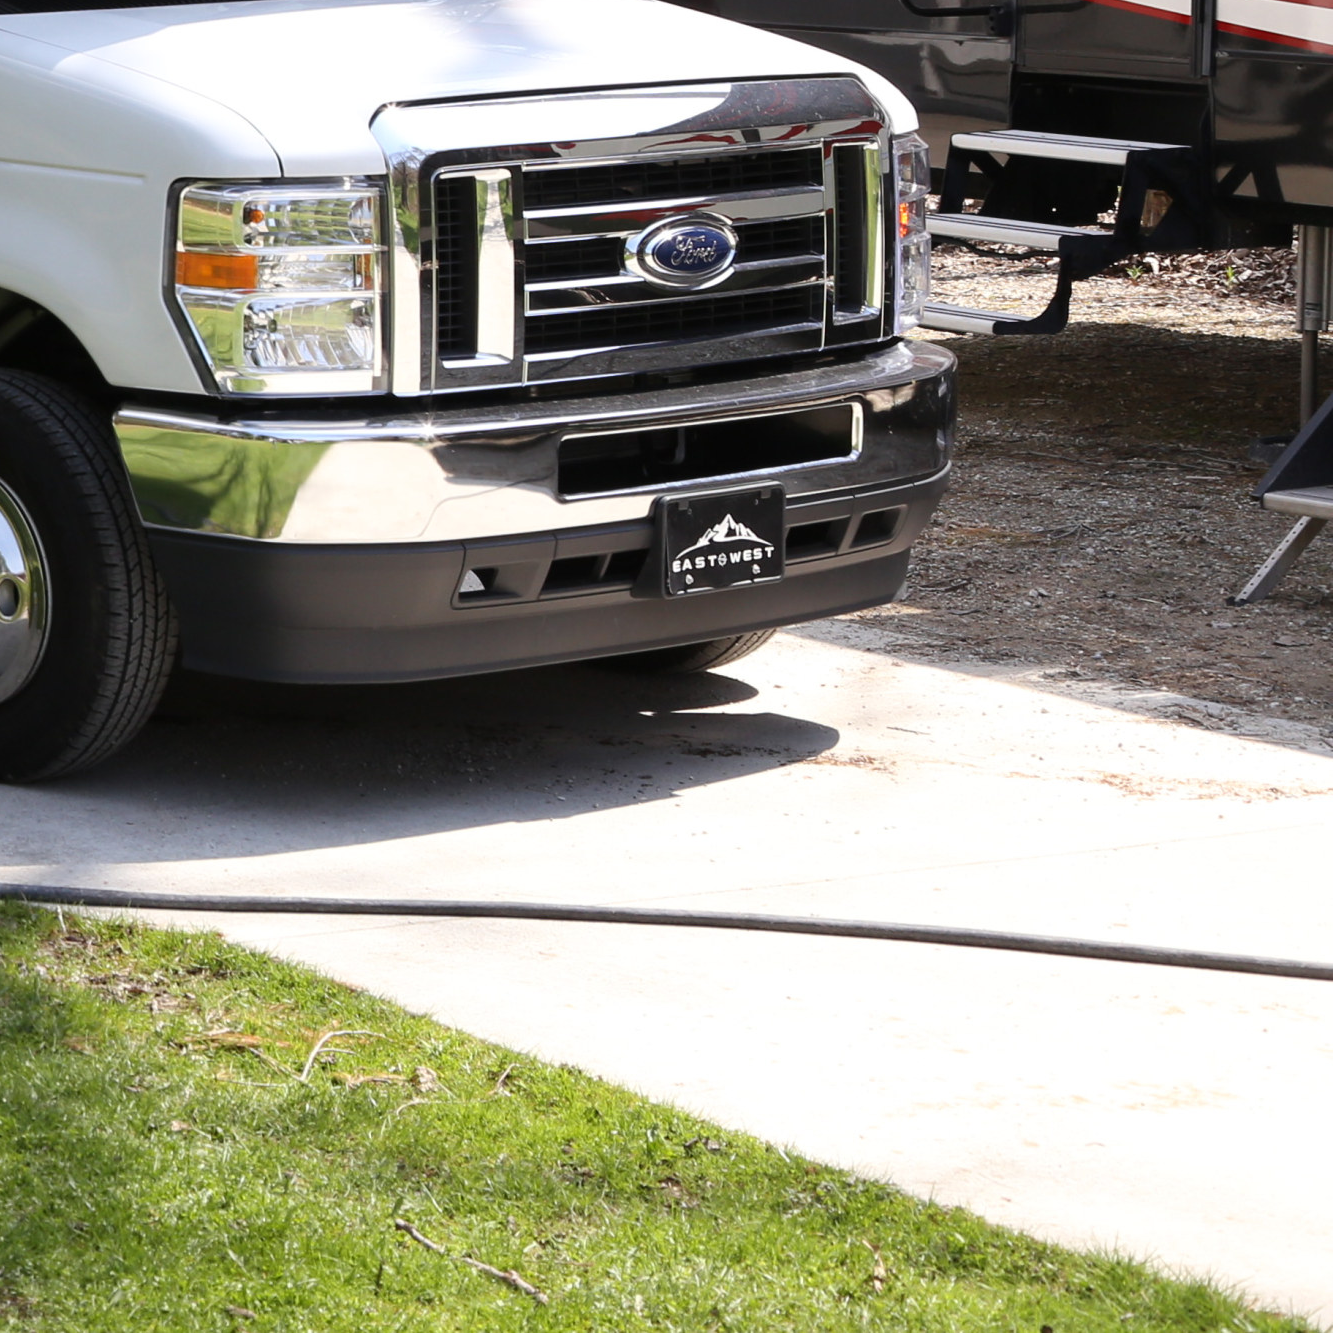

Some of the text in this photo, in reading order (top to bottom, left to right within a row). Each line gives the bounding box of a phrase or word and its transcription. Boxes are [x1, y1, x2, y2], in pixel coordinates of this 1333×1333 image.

[671, 234, 718, 266] Ford
[672, 555, 717, 573] EAST
[729, 546, 775, 564] WEST
